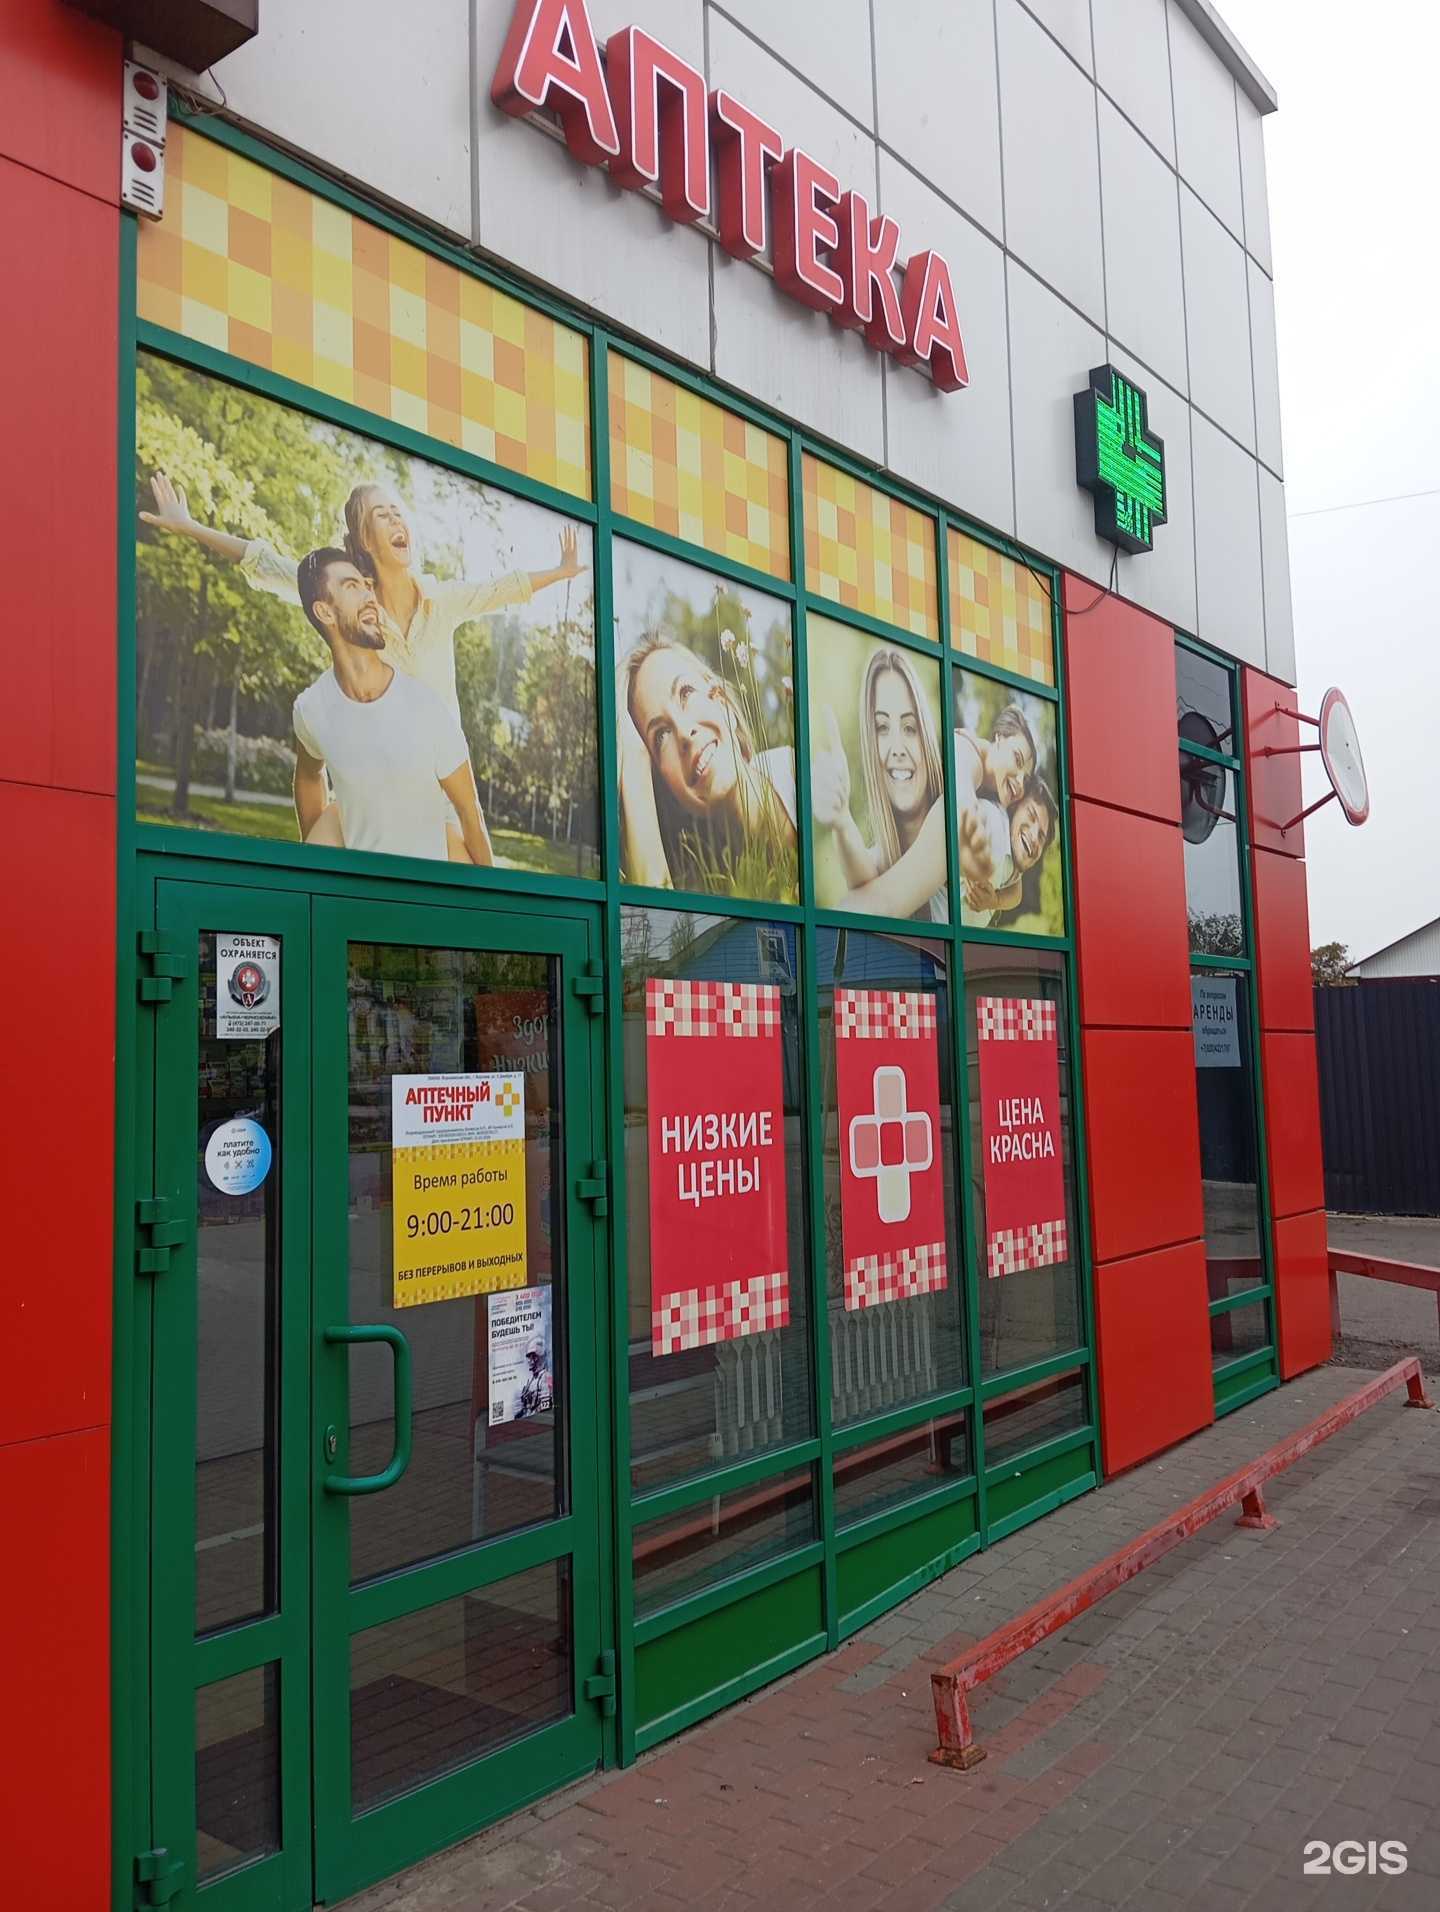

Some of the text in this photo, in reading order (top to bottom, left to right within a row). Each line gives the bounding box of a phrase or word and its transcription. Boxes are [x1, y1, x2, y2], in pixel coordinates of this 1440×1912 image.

[492, 0, 970, 394] АПТЕКА
[220, 948, 277, 960] ОХРАНЯЕТСЯ
[232, 937, 265, 948] ОБЪЕКТ
[1193, 1004, 1233, 1023] АРЕНДЫ
[405, 1081, 491, 1105] АПТЕЧНЫЙ
[423, 1104, 474, 1123] ПУНКТ
[998, 1097, 1045, 1133] ЦЕНА
[661, 1111, 774, 1154] НИЗКИЕ
[223, 1141, 254, 1149] платите
[232, 1147, 260, 1158] удобно
[990, 1130, 1055, 1164] КРАСНА
[414, 1168, 508, 1192] Время работы
[678, 1156, 761, 1208] ЦЕНЫ
[406, 1203, 514, 1239] 9:00-21:00
[398, 1252, 523, 1281] БЕЗ ПЕРЕРЫВОВ И ВЫХОДНЫХ
[491, 1311, 542, 1328] ПОБЕДИТЕЛЕМ
[491, 1326, 520, 1339] БУДЕШЬ
